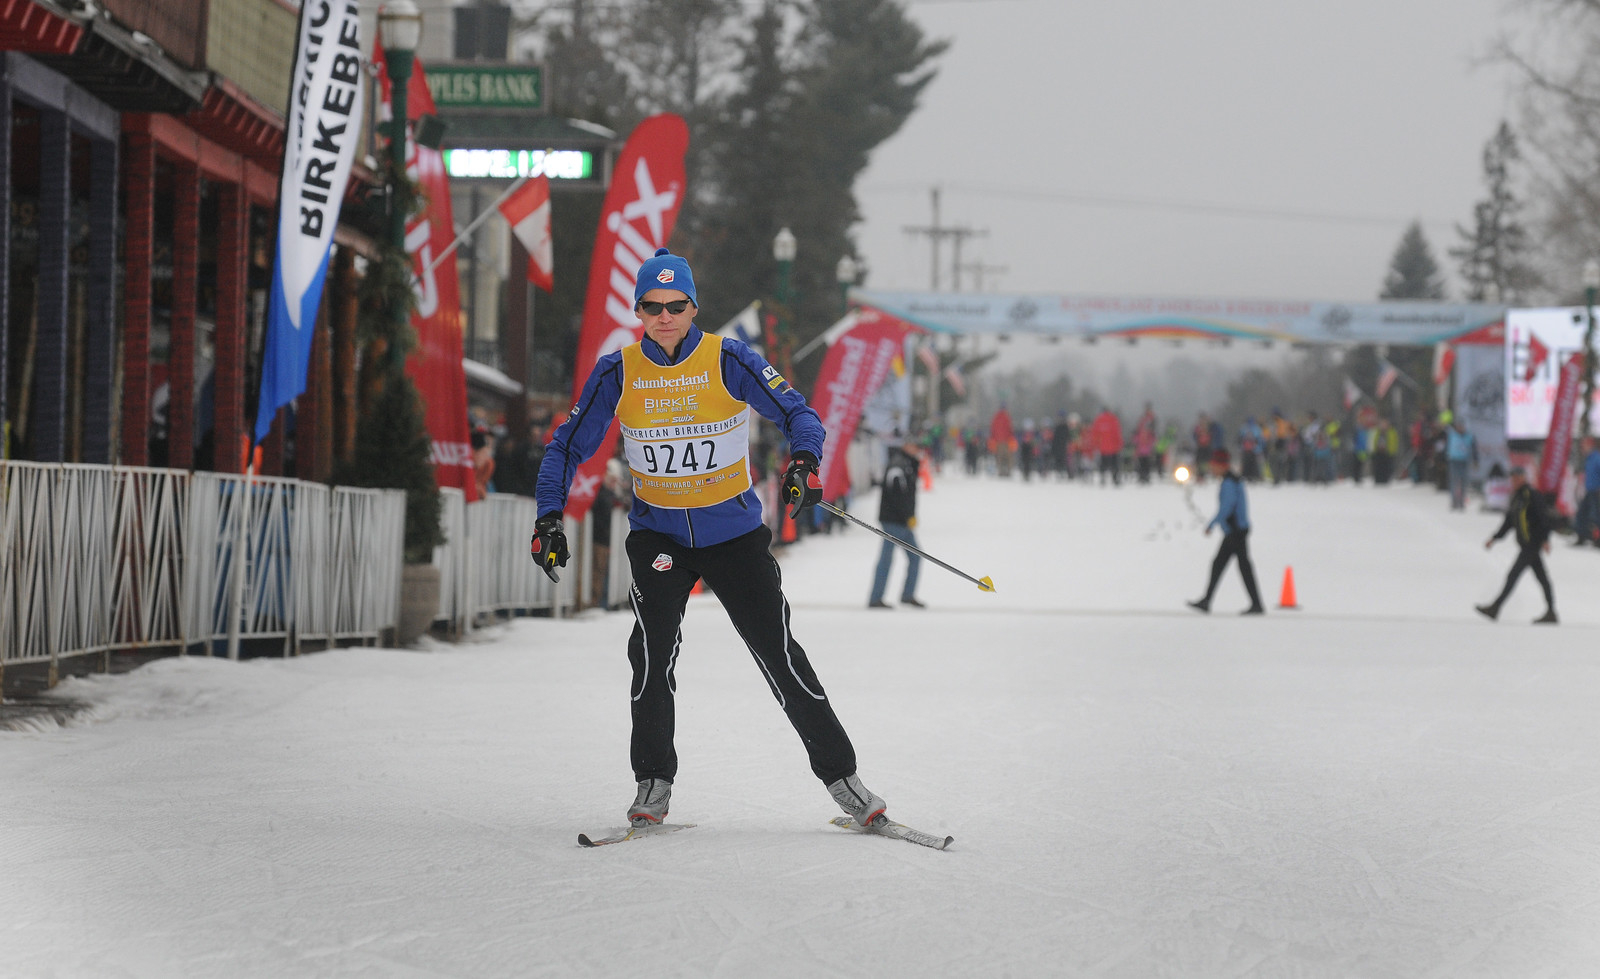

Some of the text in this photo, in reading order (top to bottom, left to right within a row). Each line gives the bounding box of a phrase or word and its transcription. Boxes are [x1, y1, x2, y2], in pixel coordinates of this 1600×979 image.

[426, 72, 537, 101] PLES BANK
[632, 371, 709, 390] slumberland
[664, 383, 710, 394] FURNITURE
[644, 394, 699, 409] BIRKIE
[675, 417, 738, 436] BIRKEBEINER
[643, 440, 718, 474] 9242
[695, 479, 705, 487] WI
[714, 473, 726, 483] USA
